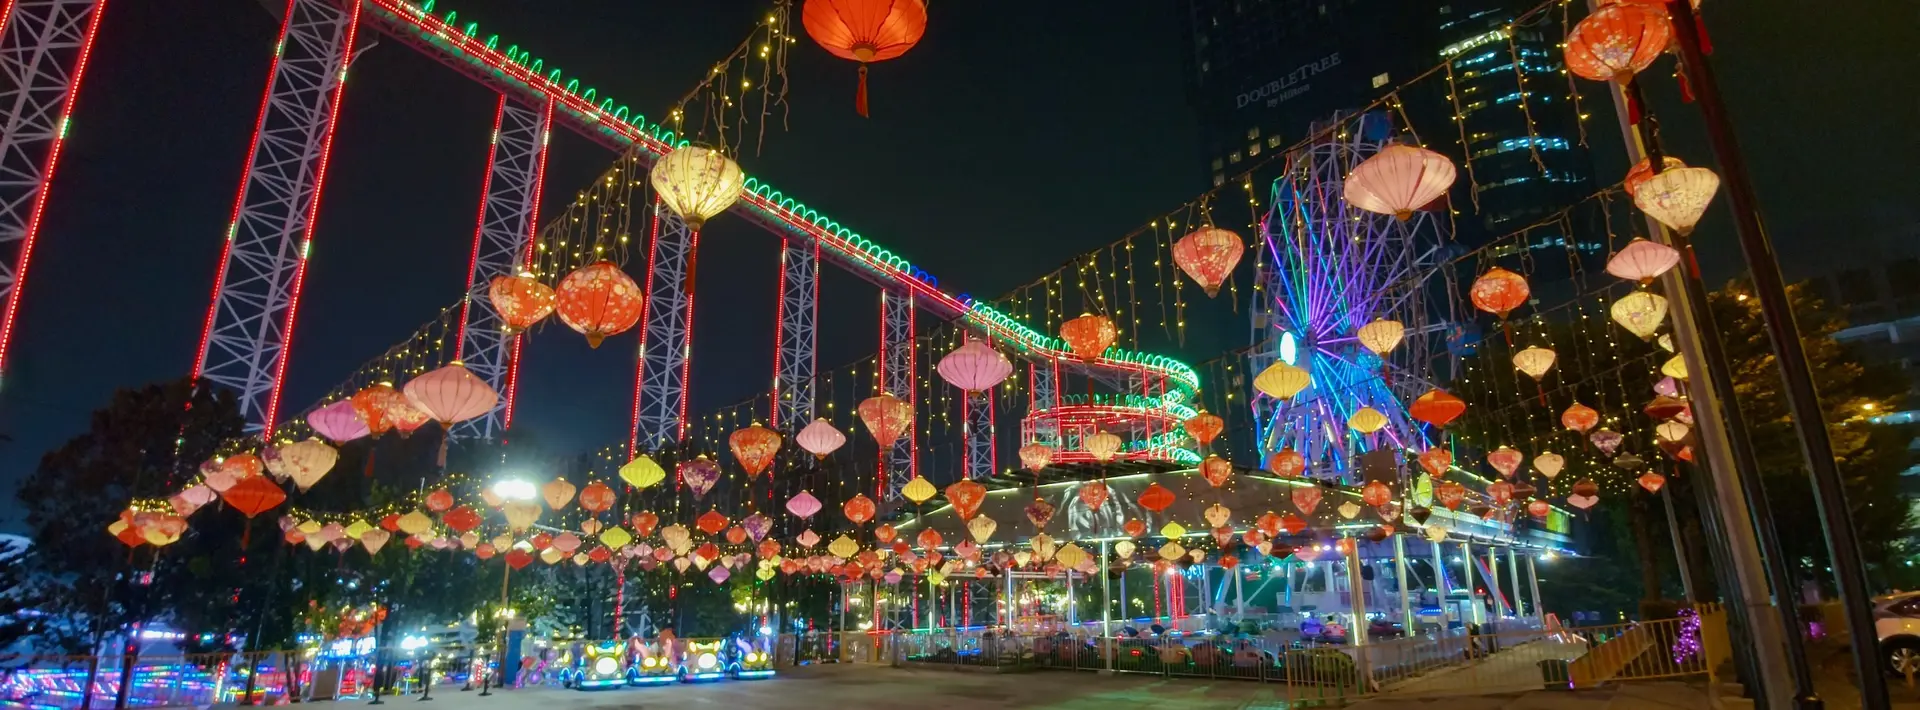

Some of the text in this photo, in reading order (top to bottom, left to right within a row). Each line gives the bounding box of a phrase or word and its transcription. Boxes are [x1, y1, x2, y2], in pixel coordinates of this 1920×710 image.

[1236, 52, 1341, 108] DOUBLETREE
[1267, 84, 1310, 108] by Hilton
